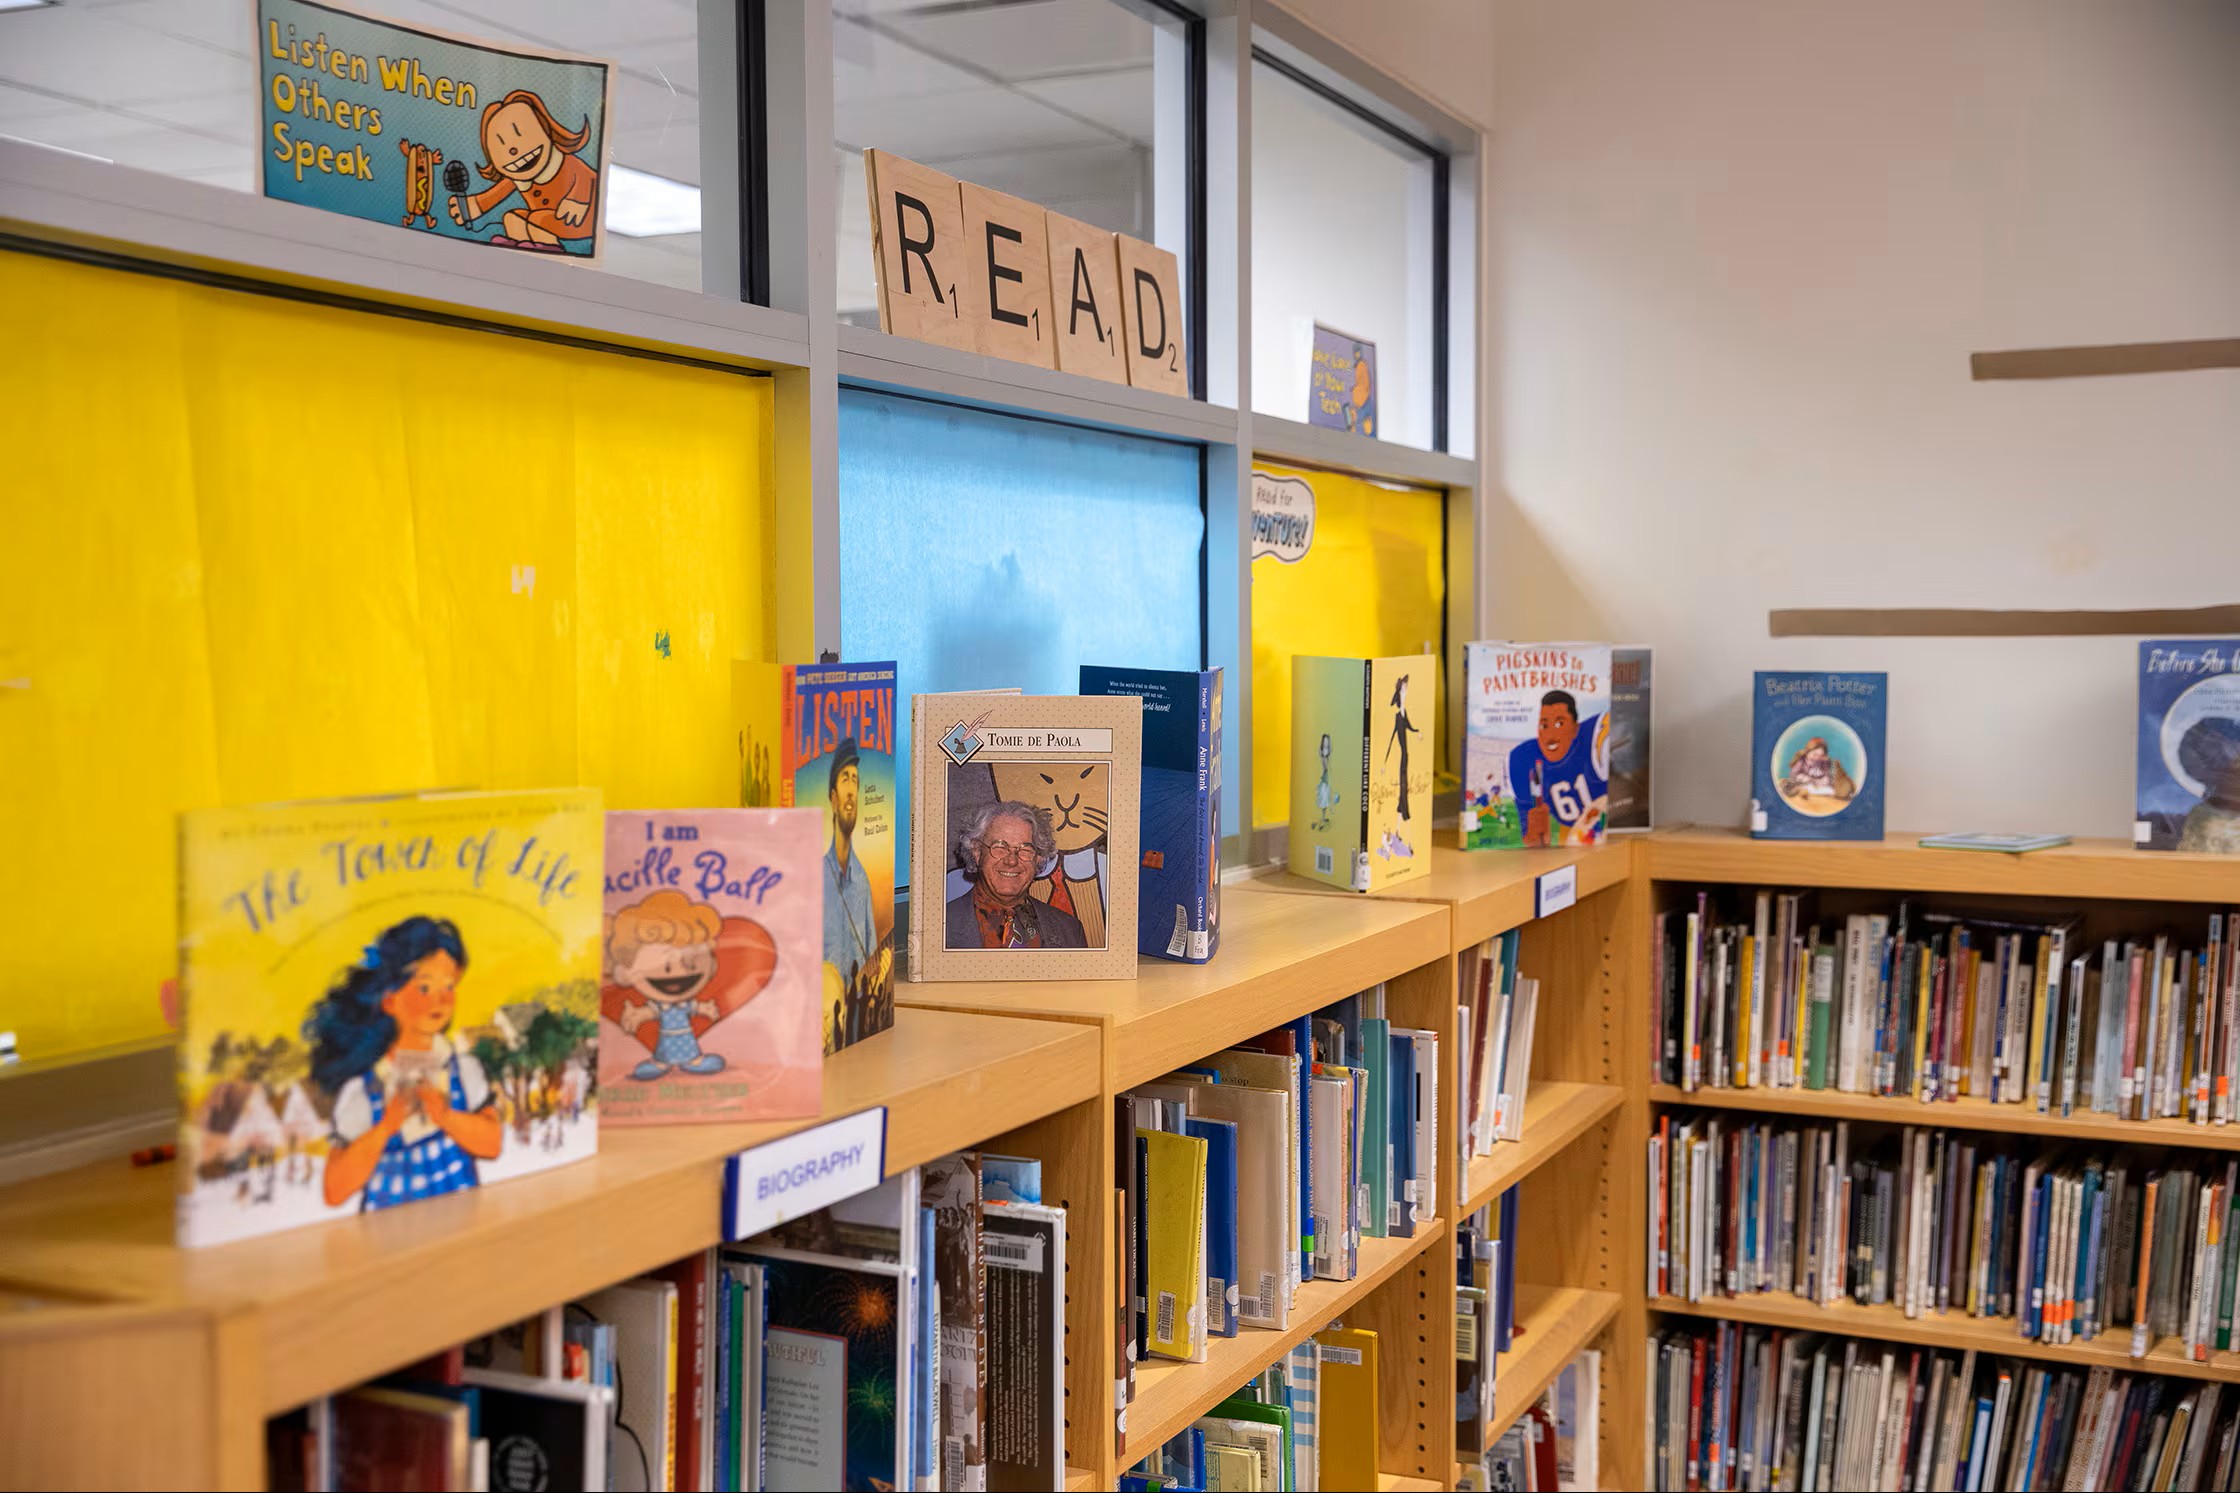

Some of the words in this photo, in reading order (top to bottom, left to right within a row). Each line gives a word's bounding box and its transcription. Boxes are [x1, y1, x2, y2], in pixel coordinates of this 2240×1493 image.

[268, 19, 369, 84] Listen
[377, 55, 477, 109] When
[272, 73, 382, 136] Others
[273, 122, 374, 181] Speak
[1496, 650, 1568, 671] PIGSKINS
[1483, 671, 1598, 695] PAINTBRUSHES
[1827, 675, 1877, 697] Potter
[1142, 702, 1154, 710] orld
[796, 688, 893, 768] LISTEN
[987, 732, 1024, 747] TOMIE
[1046, 734, 1082, 748] PAOLA
[1200, 746, 1208, 768] Anne
[1199, 770, 1208, 790] Frank
[1550, 774, 1594, 821] 61
[645, 821, 655, 841] I
[662, 825, 699, 841] am
[221, 869, 314, 933] The
[322, 835, 446, 888] Tower
[456, 829, 501, 888] of
[506, 835, 584, 906] Life
[694, 850, 784, 905] Ball
[1230, 1078, 1249, 1086] stop
[756, 1142, 865, 1200] BIOGRAPHY
[978, 1314, 986, 1335] MY
[767, 1342, 825, 1366] AUTIFUL
